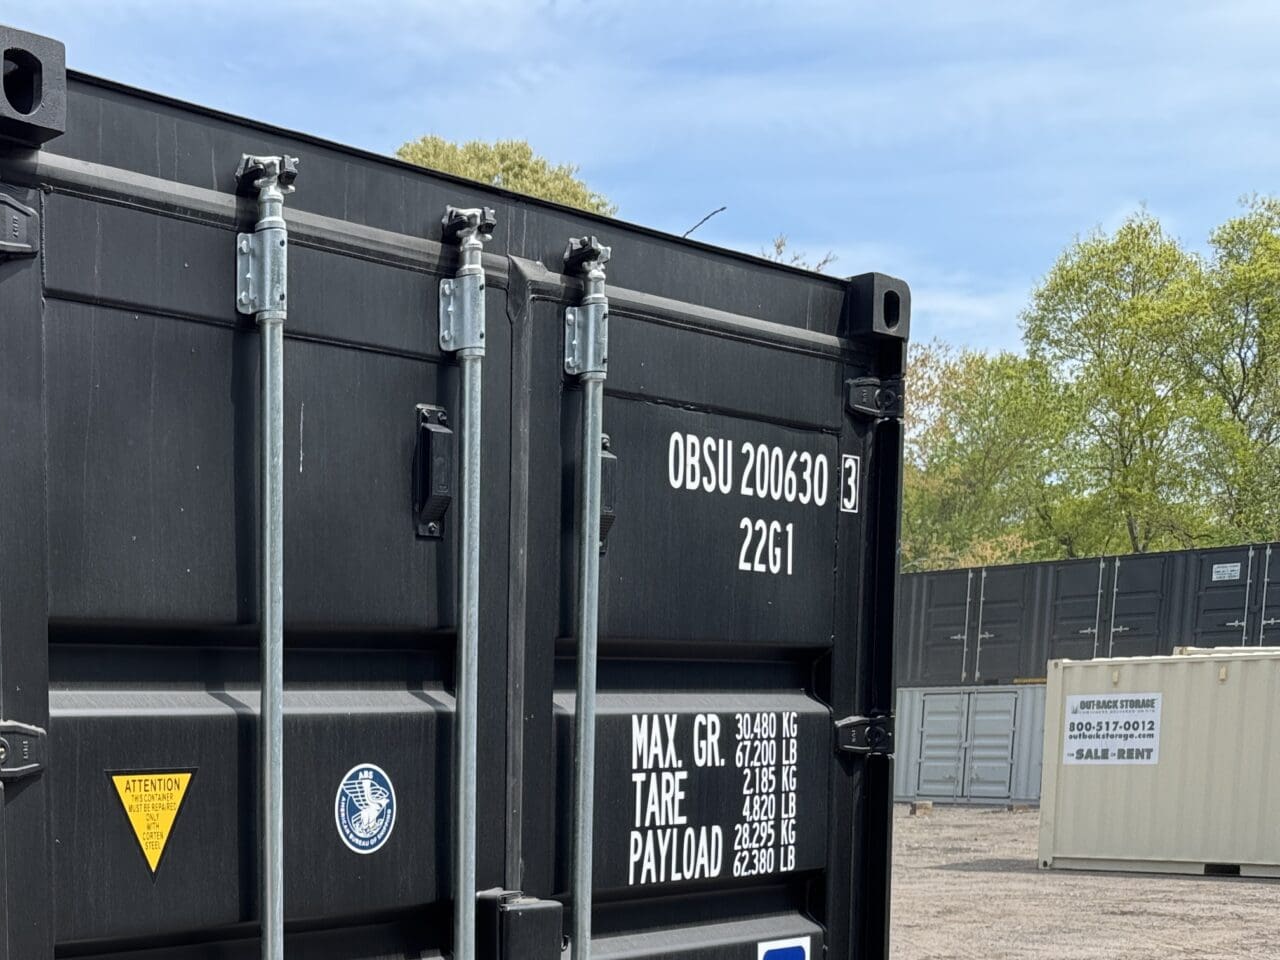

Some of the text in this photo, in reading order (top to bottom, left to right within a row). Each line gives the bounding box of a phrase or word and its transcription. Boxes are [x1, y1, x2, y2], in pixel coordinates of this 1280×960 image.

[668, 431, 858, 510] OBSU 200630 3
[738, 516, 794, 575] 22G1
[1079, 698, 1156, 710] OUTBACK STORAGE
[1069, 720, 1155, 732] 800-517-0012
[631, 713, 683, 770] MAX.
[693, 713, 725, 768] GR.
[782, 711, 798, 738] KG
[782, 738, 798, 765] LB
[1075, 748, 1109, 760] SALE
[1117, 748, 1154, 760] RENT
[124, 778, 181, 793] ATTENTION
[631, 771, 688, 828] TARE
[781, 765, 797, 792] KG
[781, 792, 797, 819] LB
[629, 825, 724, 886] PAYLOAD
[780, 819, 796, 845] KG
[780, 845, 796, 873] LB
